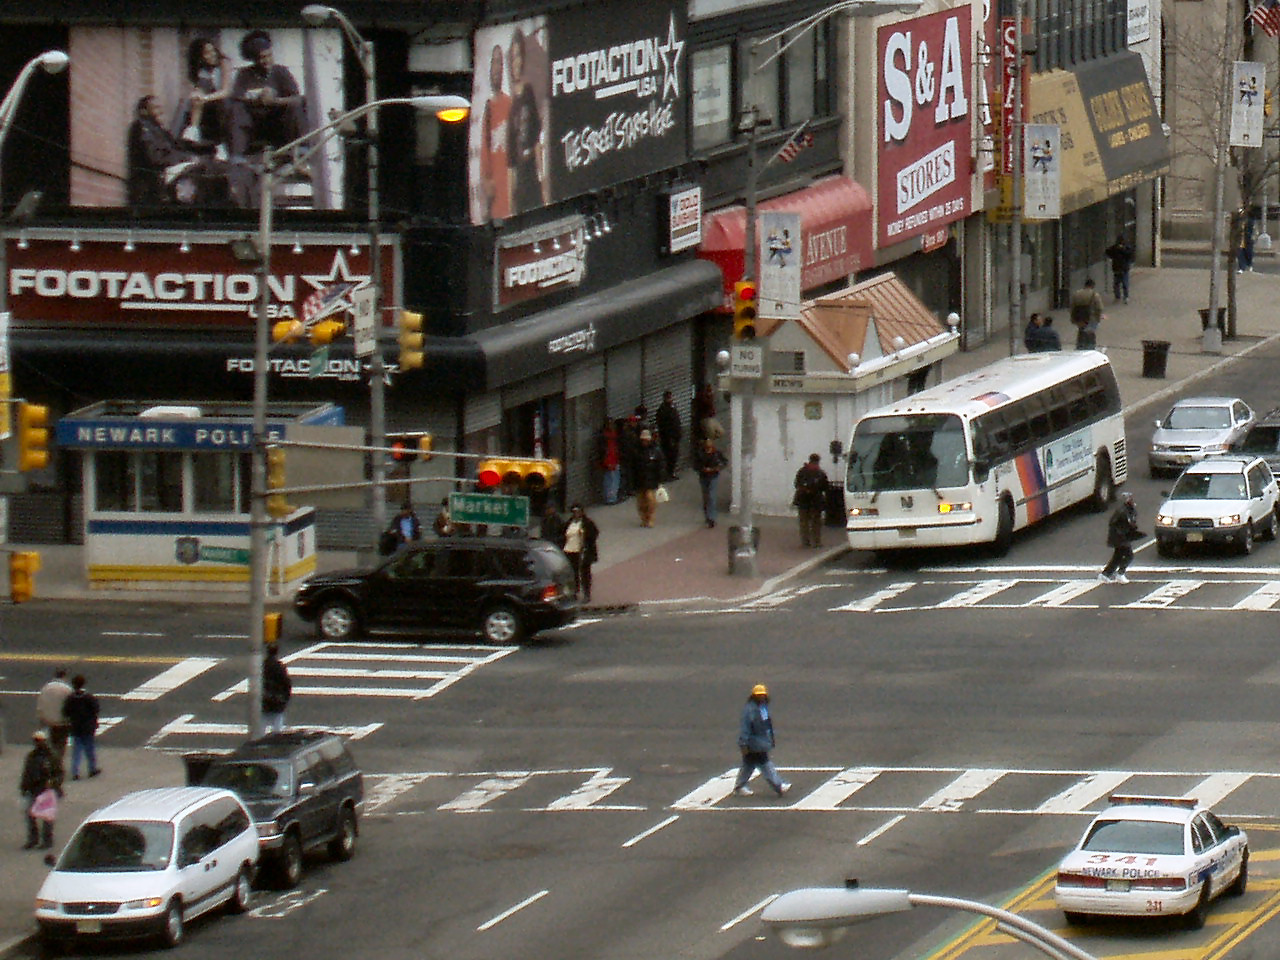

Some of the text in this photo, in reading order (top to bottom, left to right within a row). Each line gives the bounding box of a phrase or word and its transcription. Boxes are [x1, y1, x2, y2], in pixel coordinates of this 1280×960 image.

[552, 37, 659, 97] FOOTACTION
[636, 75, 658, 98] USA
[884, 16, 968, 143] S&A
[900, 149, 952, 204] STORES
[805, 225, 848, 266] AVENUE
[10, 268, 296, 303] FOOTACTION
[739, 350, 755, 361] NO
[78, 427, 281, 445] NEWARK POLIE
[453, 496, 509, 517] Market
[1086, 854, 1158, 866] 341
[1081, 867, 1160, 879] NEWARK POLICE
